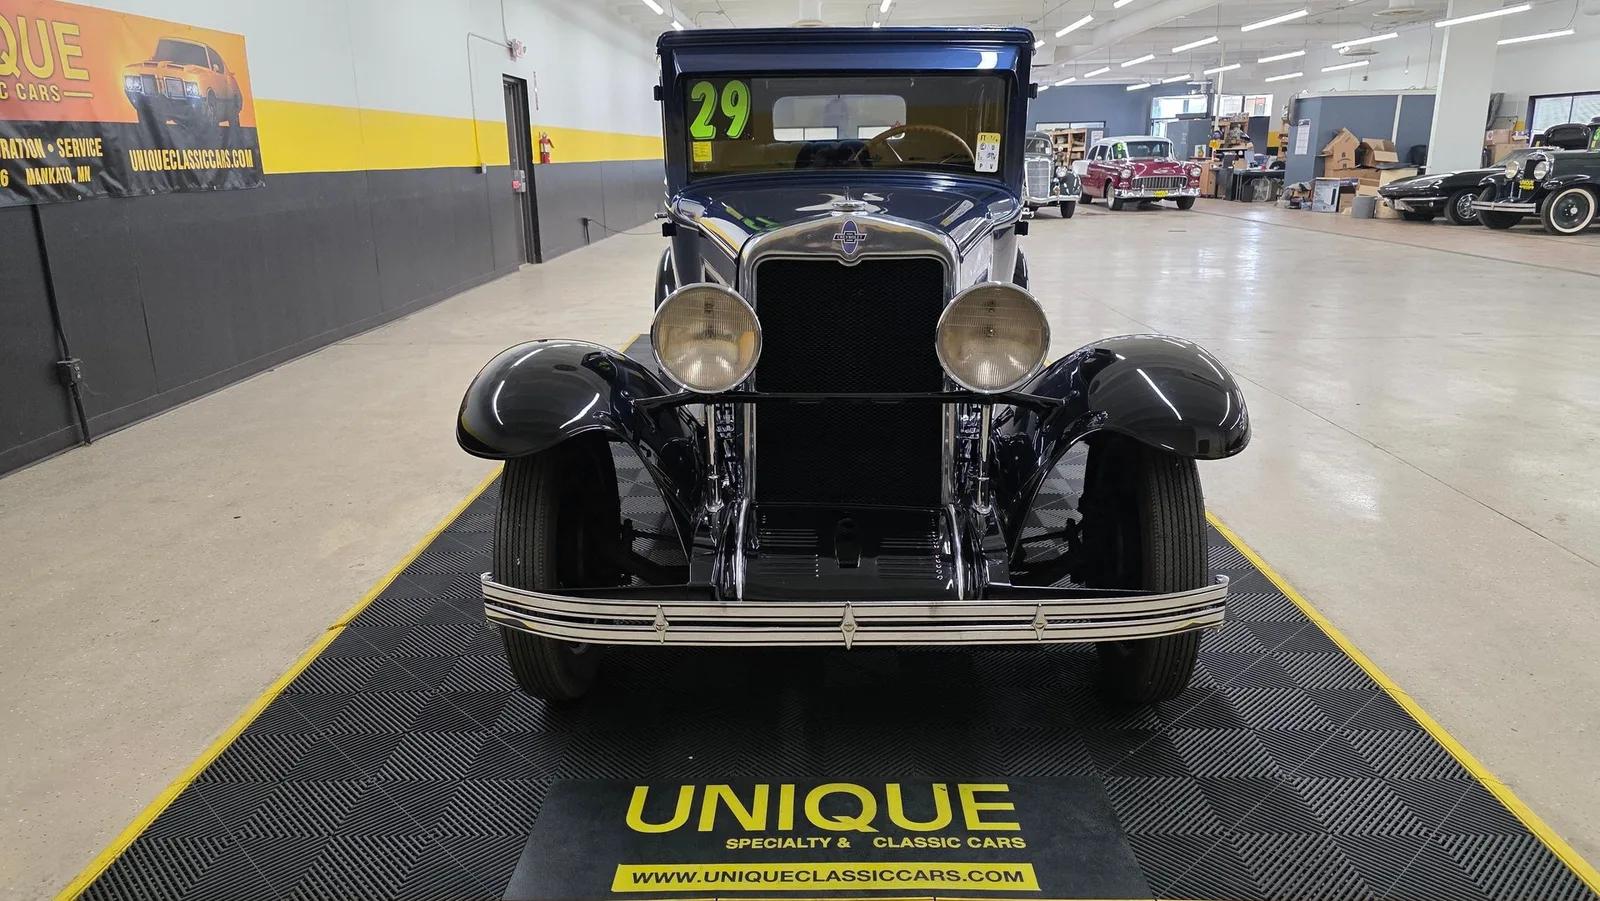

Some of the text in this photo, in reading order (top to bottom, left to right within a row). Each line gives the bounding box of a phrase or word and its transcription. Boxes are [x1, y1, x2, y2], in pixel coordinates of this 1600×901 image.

[16, 83, 61, 101] CARS
[690, 80, 750, 139] 29
[57, 138, 103, 158] SERVICE
[129, 149, 254, 171] UNIQUECLASSICCARS.COM
[25, 167, 76, 186] MANKATO,
[77, 166, 91, 182] MN
[626, 783, 1020, 834] UNIQUE
[726, 837, 1026, 849] SPECIALTY & CLASSIC CARS
[632, 870, 1024, 884] WWW.UNIQUECLASSICCARS.COM
